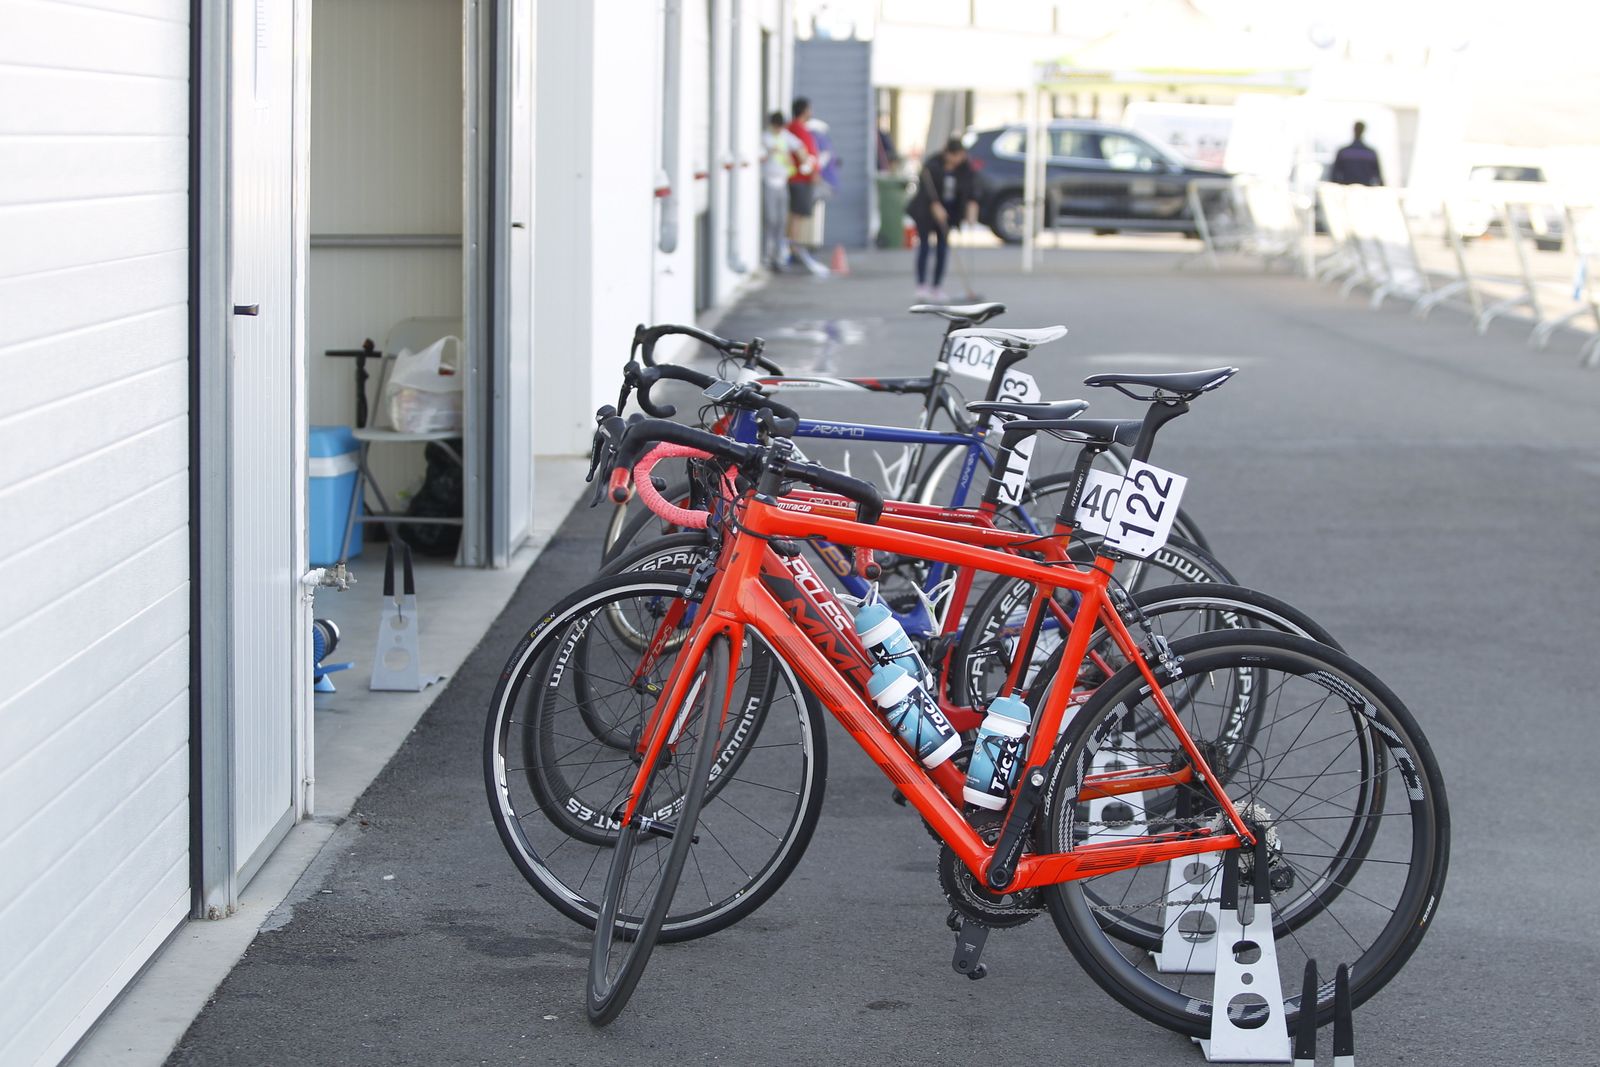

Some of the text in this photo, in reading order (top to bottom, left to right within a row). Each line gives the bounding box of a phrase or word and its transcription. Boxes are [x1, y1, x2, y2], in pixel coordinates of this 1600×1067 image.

[953, 342, 995, 370] 404
[1119, 470, 1173, 538] 122
[782, 556, 852, 631] PICLES
[1044, 742, 1072, 816] CONTINENTAL
